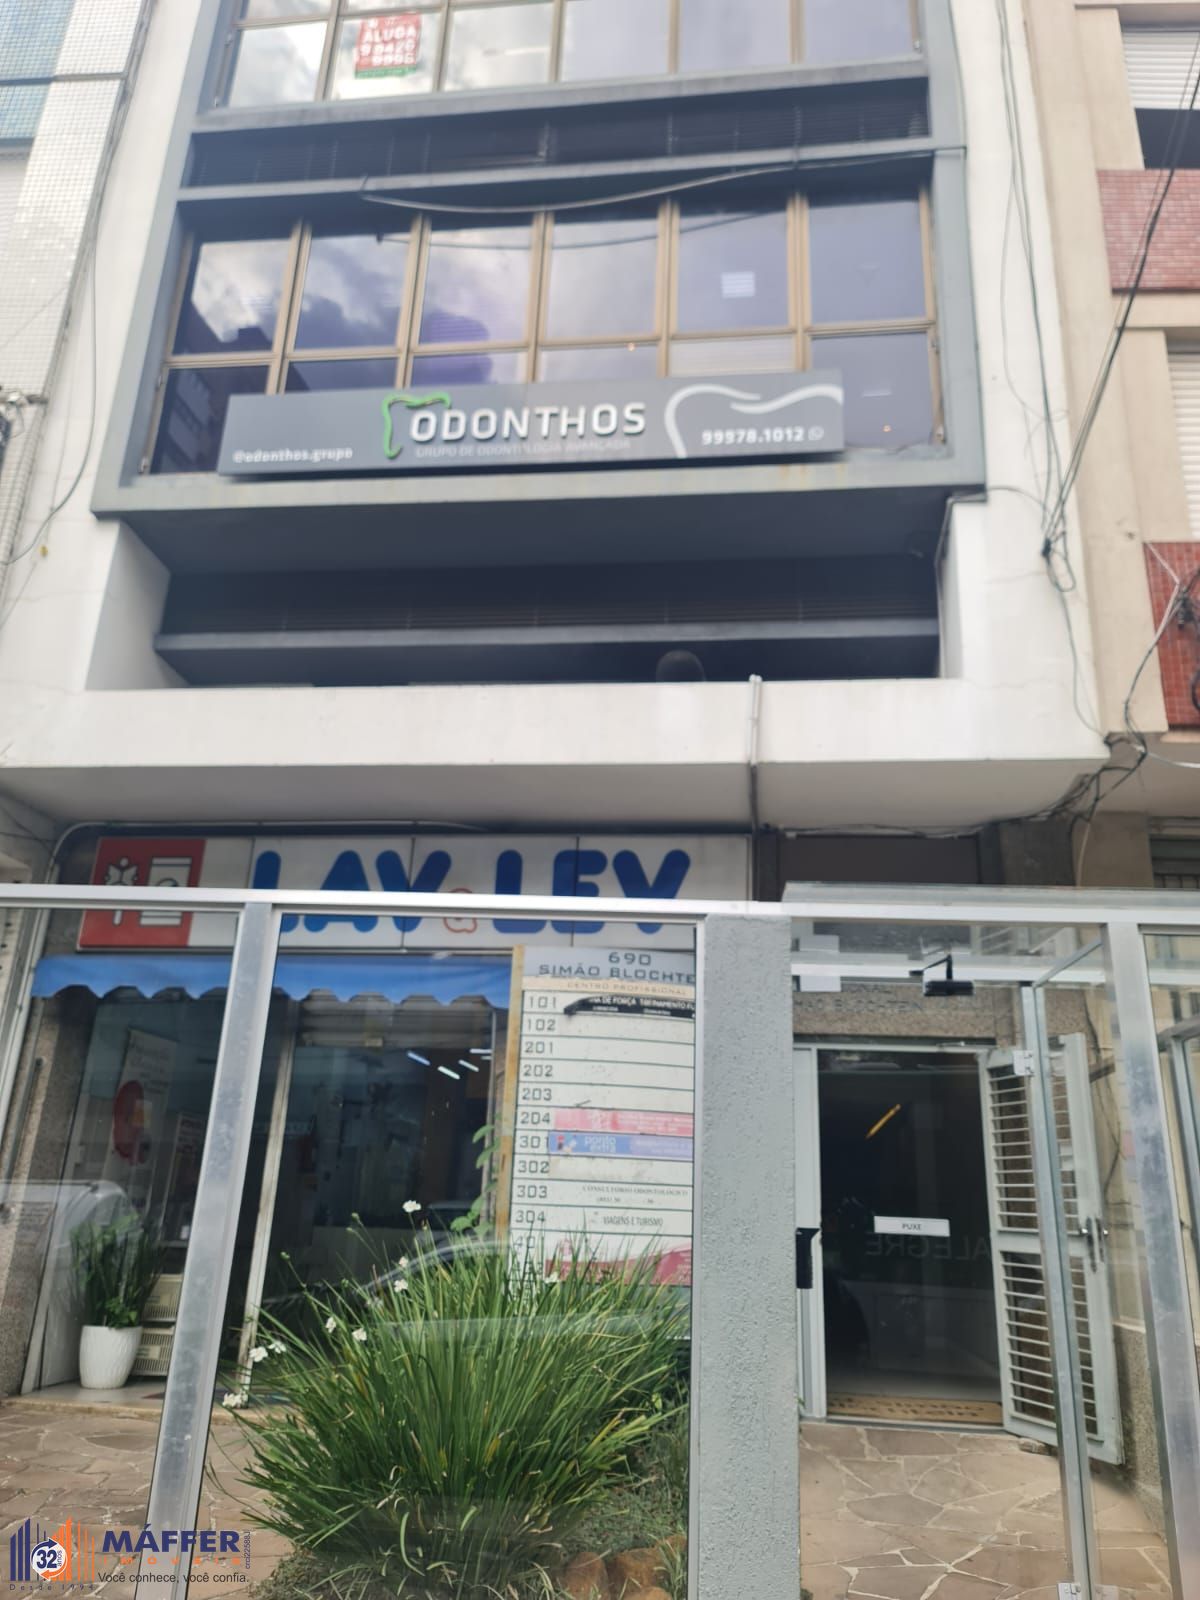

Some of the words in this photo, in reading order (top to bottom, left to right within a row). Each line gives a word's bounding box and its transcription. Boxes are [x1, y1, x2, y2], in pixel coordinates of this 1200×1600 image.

[410, 402, 647, 442] ODONTHOS
[701, 425, 806, 445] 99978.1012
[608, 952, 652, 966] 690
[539, 963, 601, 977] SIMÃO
[529, 996, 558, 1009] 101
[526, 1018, 557, 1032] 102
[524, 1041, 555, 1055] 201
[523, 1064, 554, 1078] 202
[522, 1087, 553, 1101] 203
[520, 1111, 551, 1125] 204
[517, 1159, 551, 1174] 302
[516, 1184, 548, 1199] 303
[515, 1210, 546, 1224] 304
